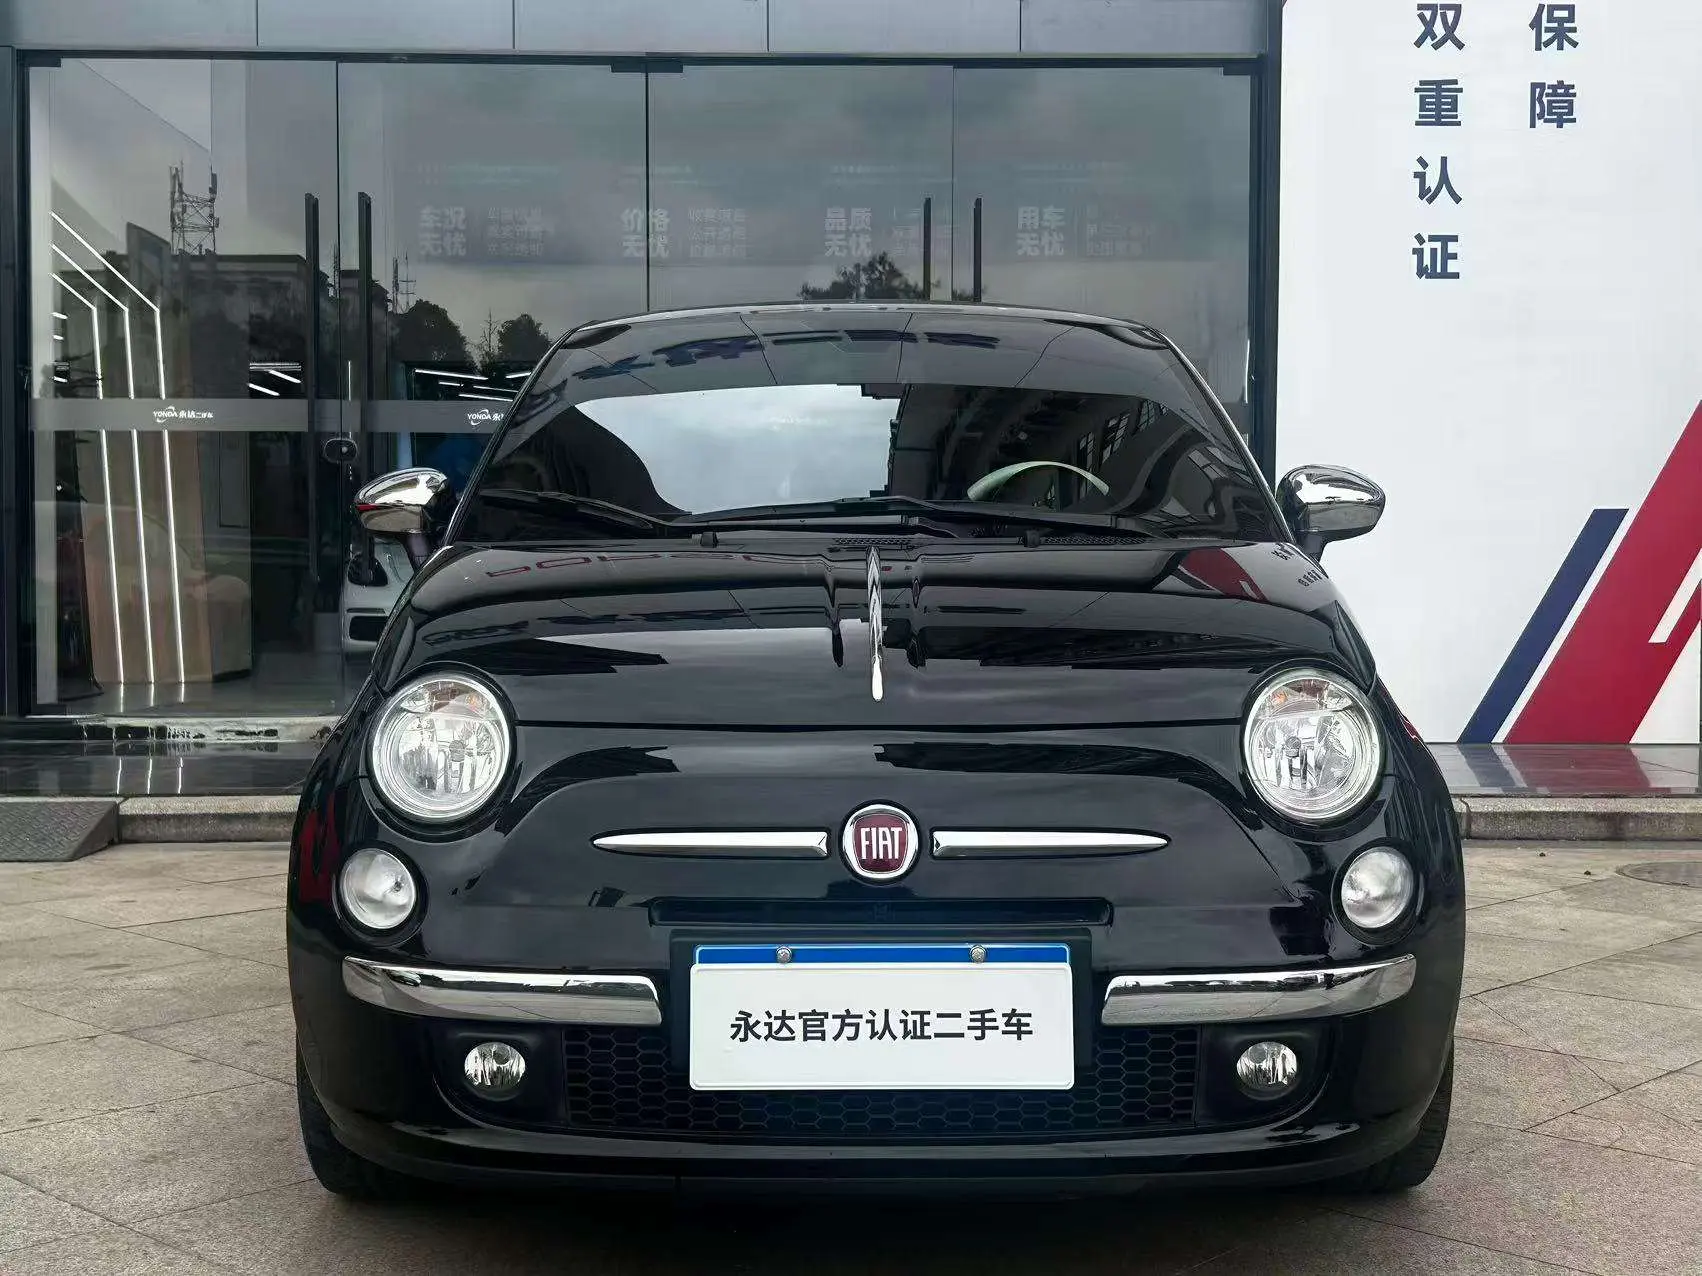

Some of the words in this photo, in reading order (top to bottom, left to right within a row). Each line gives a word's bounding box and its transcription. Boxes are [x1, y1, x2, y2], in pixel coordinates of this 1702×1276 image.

[1528, 3, 1579, 129] 保障
[1411, 3, 1466, 280] 双重认证
[824, 206, 872, 231] 品质
[1017, 205, 1066, 230] 用车
[824, 232, 872, 257] 无忧
[1016, 232, 1065, 256] 无忧
[860, 827, 902, 860] FIAT
[729, 1008, 1033, 1043] 永达官方认证二手车
